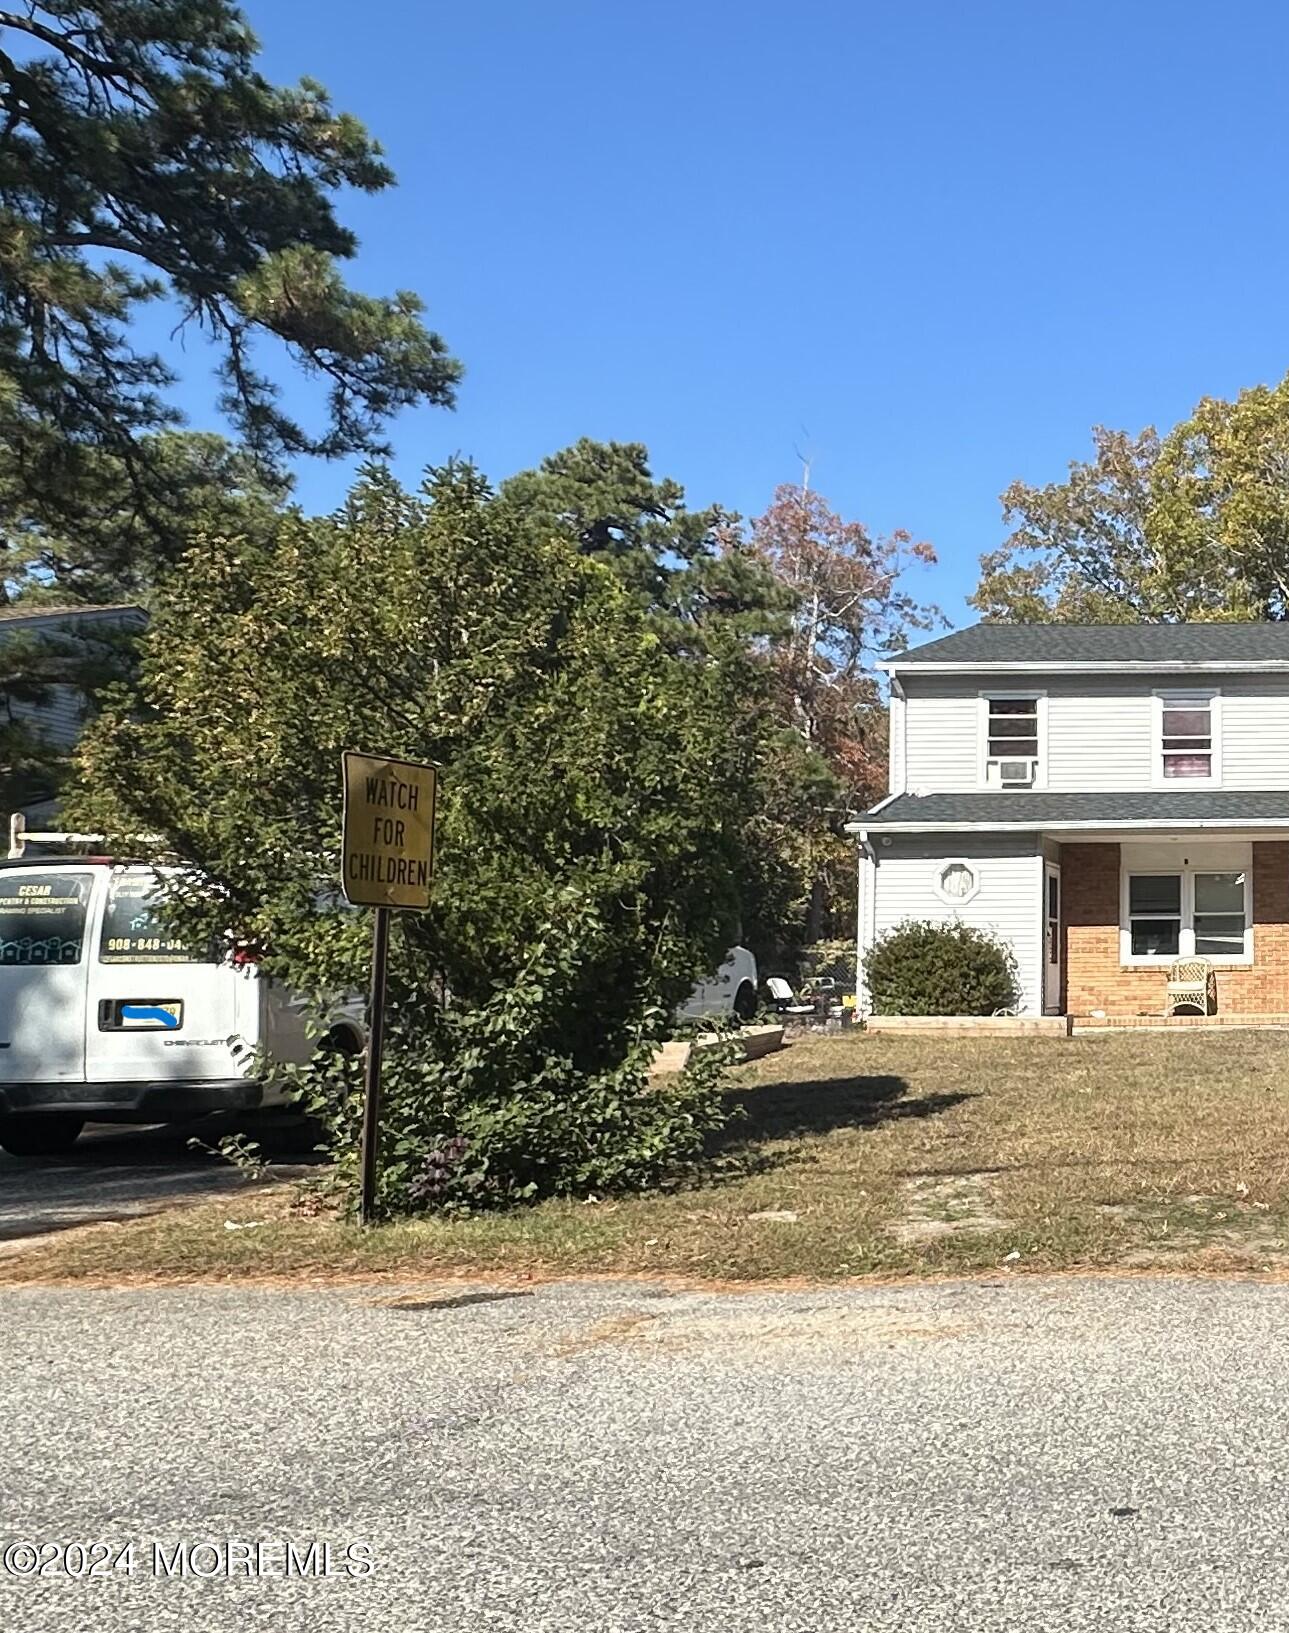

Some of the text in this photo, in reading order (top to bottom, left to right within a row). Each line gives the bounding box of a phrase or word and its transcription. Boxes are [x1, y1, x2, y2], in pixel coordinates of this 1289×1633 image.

[365, 776, 419, 811] WATCH
[373, 817, 405, 847] FOR
[349, 853, 427, 886] CHILDREN
[18, 885, 52, 896] CESAR
